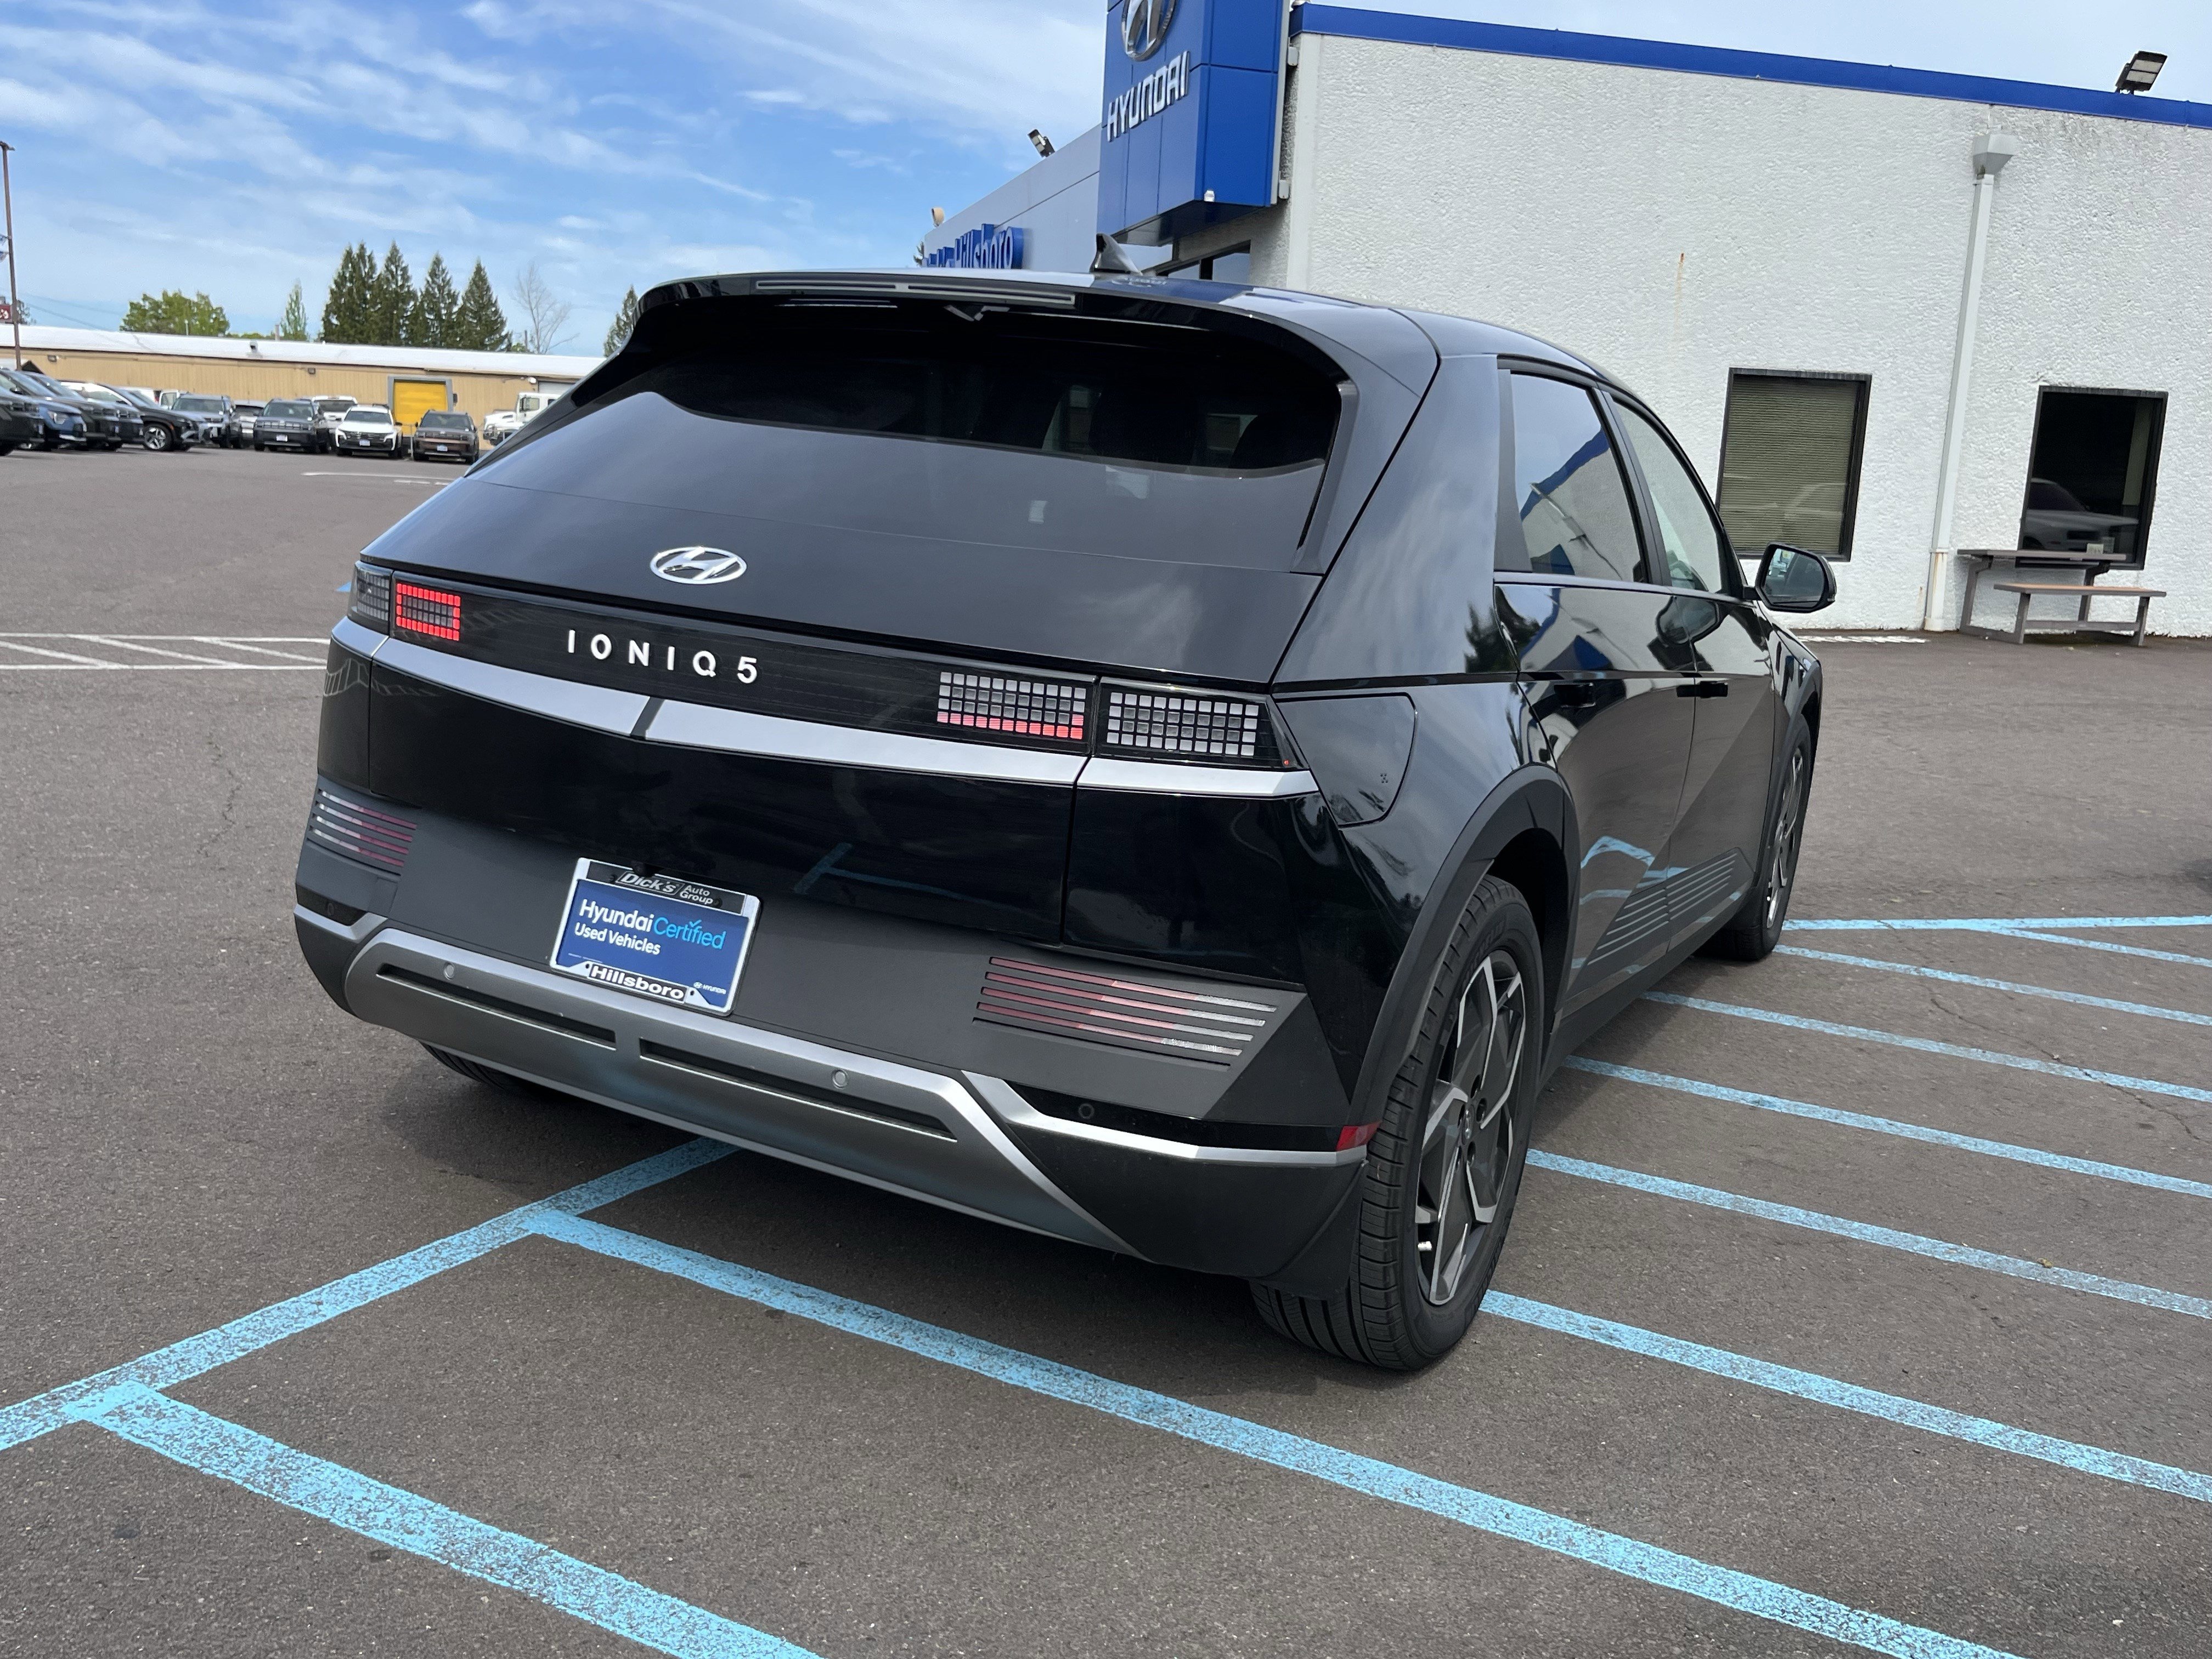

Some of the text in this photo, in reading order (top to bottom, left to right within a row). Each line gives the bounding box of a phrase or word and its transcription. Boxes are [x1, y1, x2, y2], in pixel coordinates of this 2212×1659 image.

[1107, 50, 1189, 143] HYUNDAI
[568, 630, 757, 684] IONIQ 5
[680, 891, 713, 905] Group
[686, 885, 710, 896] Auto
[575, 922, 661, 955] Used Vehicles
[579, 899, 727, 950] Hyundai Certified
[591, 965, 684, 1000] Hillsboro
